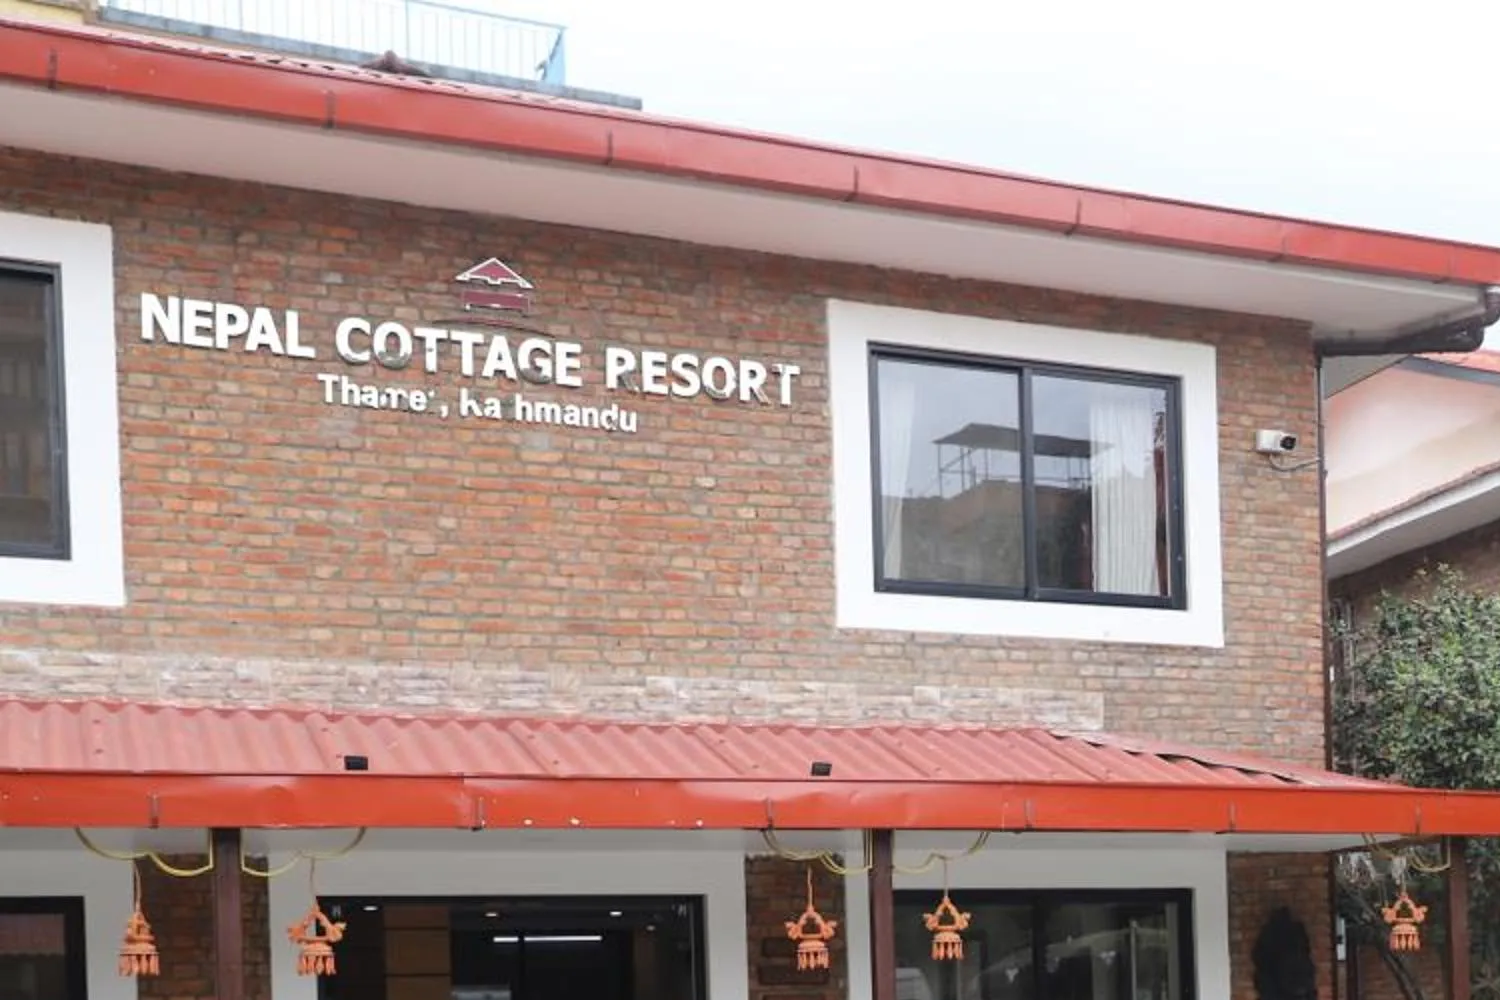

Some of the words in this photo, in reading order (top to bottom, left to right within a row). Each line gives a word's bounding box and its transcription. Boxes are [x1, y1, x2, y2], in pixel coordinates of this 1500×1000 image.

[140, 292, 316, 358] NEPAL
[335, 317, 582, 388] COTTAGE
[605, 346, 800, 405] RESORT
[317, 373, 449, 418] Thame,
[460, 387, 637, 432] Kahmandu
